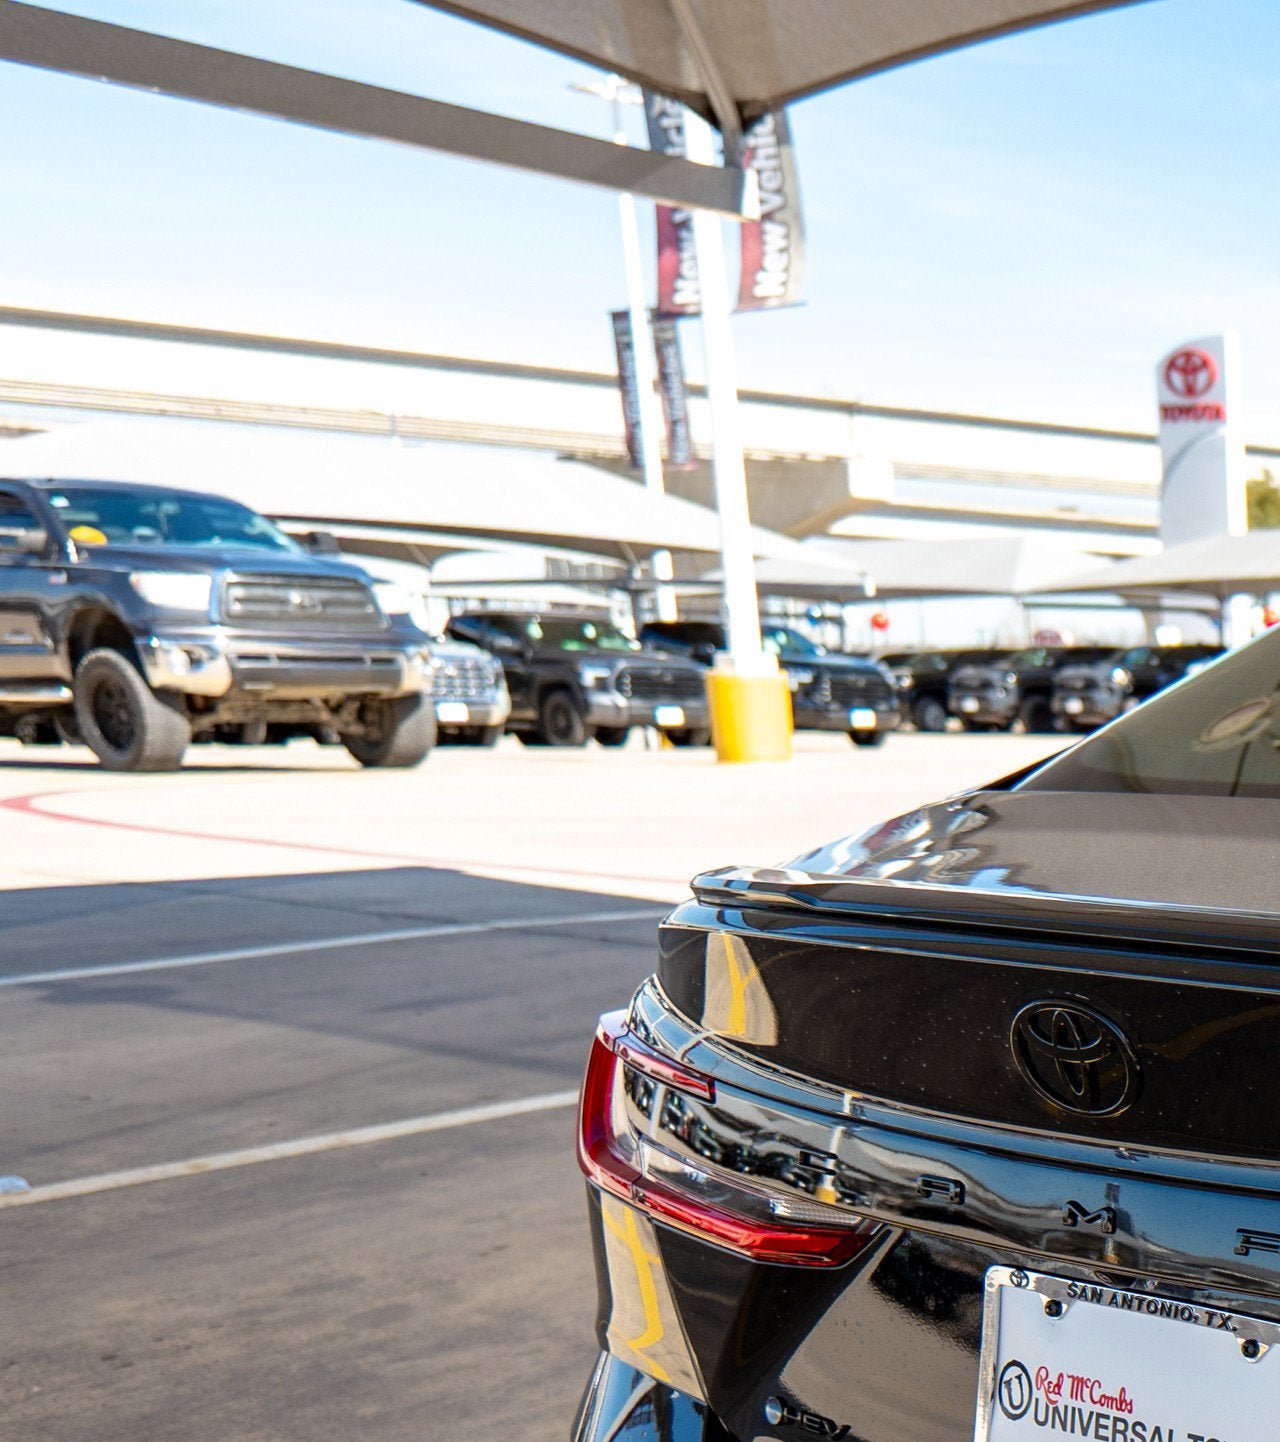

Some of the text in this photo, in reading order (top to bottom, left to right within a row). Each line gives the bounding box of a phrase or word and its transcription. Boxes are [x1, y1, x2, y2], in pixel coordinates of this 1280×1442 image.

[753, 221, 790, 298] New
[1160, 402, 1226, 423] TOYOTA
[1067, 1281, 1238, 1332] SAN ANTONIO, TX.
[1035, 1365, 1133, 1415] Red McCombs
[782, 1405, 851, 1441] HEV
